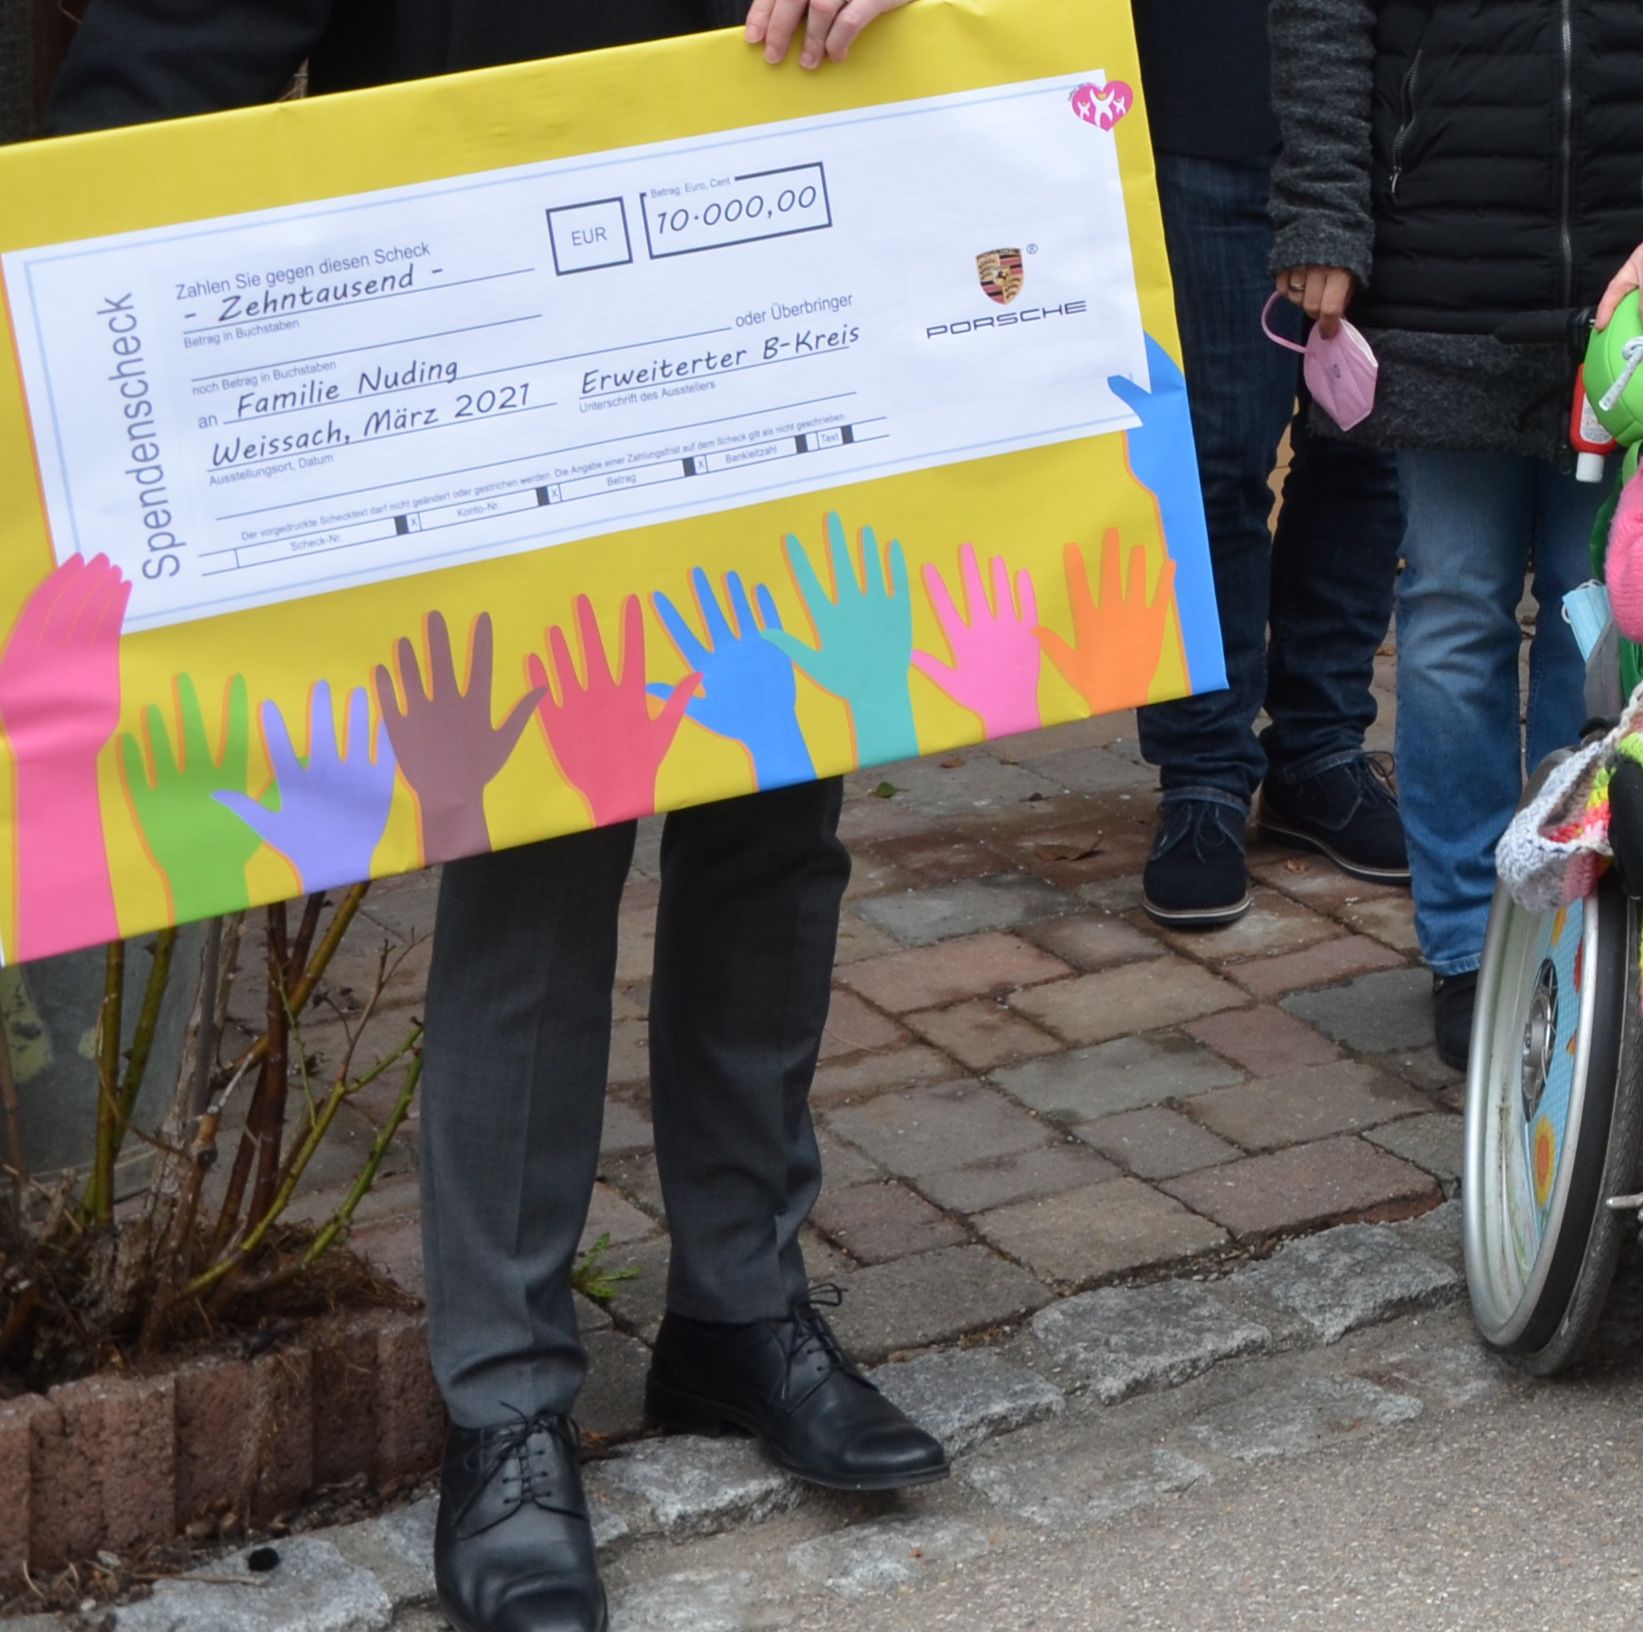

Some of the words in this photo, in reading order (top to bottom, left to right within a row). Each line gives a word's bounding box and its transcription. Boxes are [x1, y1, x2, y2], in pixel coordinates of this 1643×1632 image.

[710, 176, 731, 189] Cent
[571, 226, 608, 247] EUR
[176, 279, 231, 300] Zahlen
[235, 273, 261, 290] Sie
[266, 263, 315, 287] gegen
[319, 253, 369, 275] diesen
[374, 241, 431, 265] Scheck
[217, 262, 415, 322] Zehntausend
[735, 310, 767, 328] oder
[770, 293, 854, 321] Überbringer
[926, 300, 1088, 339] PORSCHE
[184, 332, 221, 349] Betrag
[224, 330, 233, 341] in
[235, 318, 300, 340] Buchstaben
[581, 349, 748, 395] Erweiterter
[762, 323, 860, 361] B-Kreis
[192, 380, 219, 396] noch
[222, 373, 258, 391] Betrag
[261, 372, 270, 383] in
[273, 359, 337, 381] Buchstaben
[237, 379, 340, 418] Familie
[358, 359, 459, 395] Nuding
[579, 393, 638, 414] Unterschrift
[640, 389, 659, 402] des
[661, 379, 716, 399] Ausstellers
[96, 292, 187, 581] Spendenscheck
[198, 415, 218, 429] an
[212, 419, 351, 467] Weissach,
[363, 406, 439, 437] März
[454, 382, 530, 419] 2021
[820, 432, 840, 444] Text
[208, 460, 296, 487] Ausstellungsort,
[298, 452, 334, 469] Datum
[724, 445, 778, 465] Bankleitzahl
[241, 529, 258, 541] Der
[259, 519, 318, 539] vorgedruckte
[319, 507, 368, 526] Schecktext
[370, 503, 387, 515] darf
[389, 498, 411, 512] nicht
[412, 490, 451, 509] geändert
[452, 486, 473, 499] oder
[474, 478, 519, 497] gestrichen
[554, 467, 569, 478] Die
[571, 460, 601, 475] Angabe
[604, 456, 625, 467] einer
[626, 445, 681, 464] Zahlungsfrist
[682, 442, 697, 454] auf
[697, 439, 715, 450] dem
[716, 432, 747, 446] Scheck
[749, 430, 761, 442] gilt
[762, 426, 774, 437] als
[775, 422, 795, 434] nicht
[606, 473, 637, 487] Betrag
